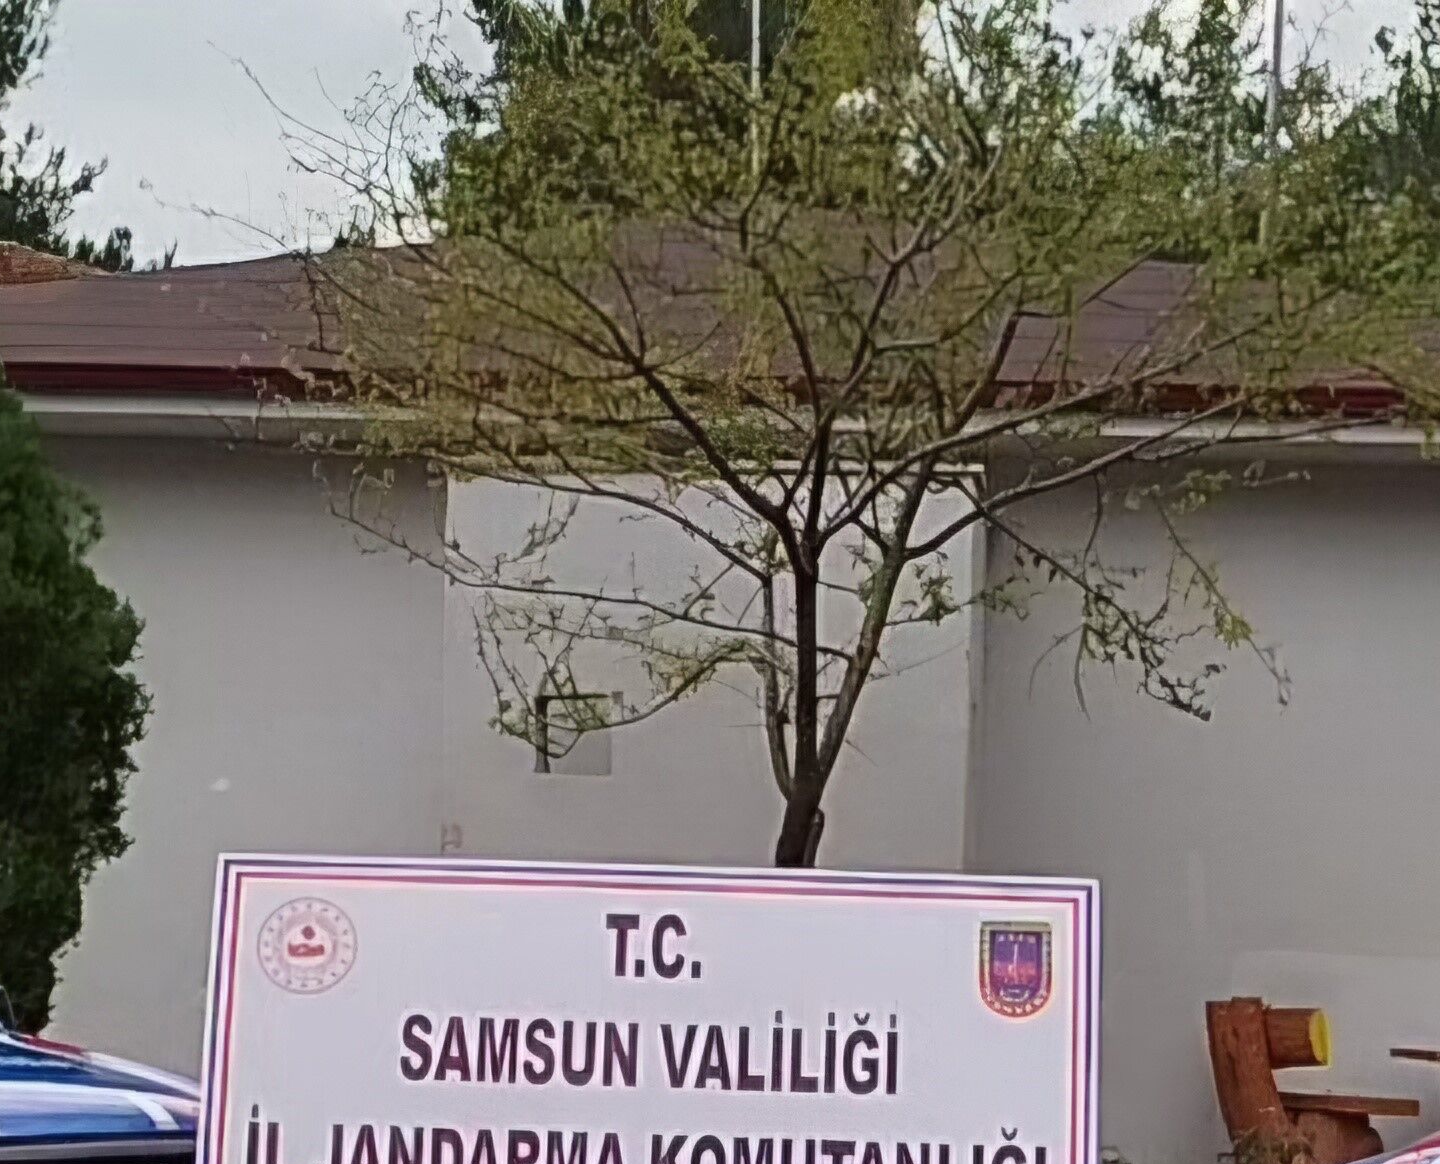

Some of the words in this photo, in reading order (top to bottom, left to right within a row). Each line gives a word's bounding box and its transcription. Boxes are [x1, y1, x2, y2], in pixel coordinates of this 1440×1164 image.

[605, 913, 702, 980] T.C.
[400, 1013, 639, 1088] SAMSUN
[660, 1010, 899, 1095] VALİLİĞİ
